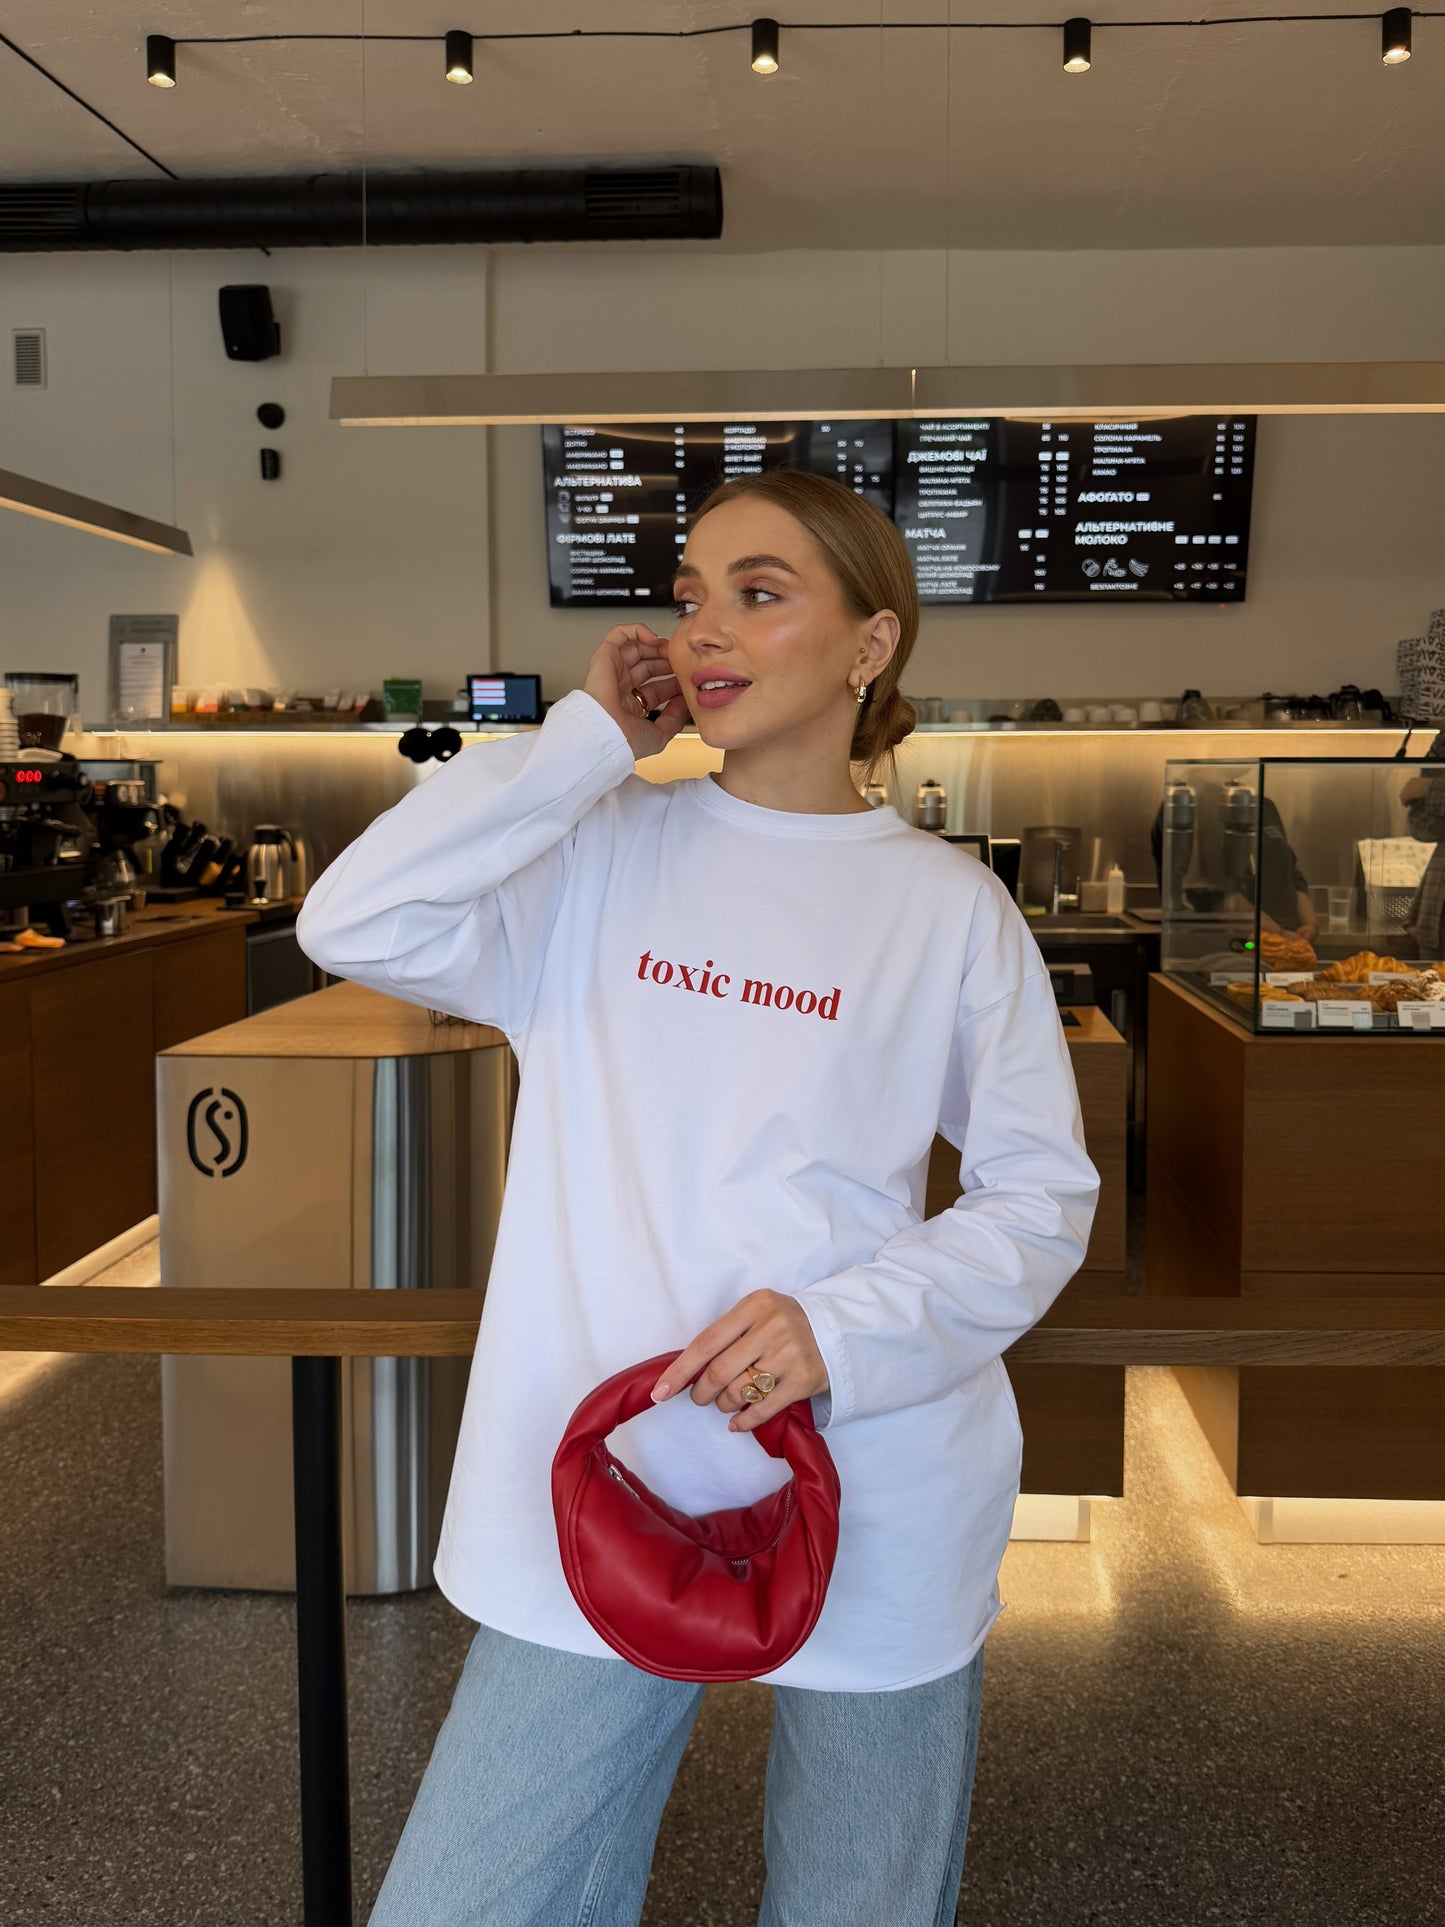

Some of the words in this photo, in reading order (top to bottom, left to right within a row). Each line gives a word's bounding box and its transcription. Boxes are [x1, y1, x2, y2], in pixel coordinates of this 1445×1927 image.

[907, 450, 964, 463] ДЖЕМОВІ
[966, 449, 987, 461] ЧАЇ
[554, 475, 642, 486] АЛЬТЕРНАТИВА
[1078, 492, 1134, 502] АФОГАТО
[1075, 522, 1174, 532] АЛЬТЕРНАТИВНЕ
[557, 533, 606, 543] ФІРМОВІ
[606, 533, 636, 543] ЛАТЕ
[905, 528, 946, 538] МАТЧА
[1075, 534, 1128, 545] МОЛОКО
[637, 949, 730, 998] toxic
[740, 978, 842, 1021] mood
